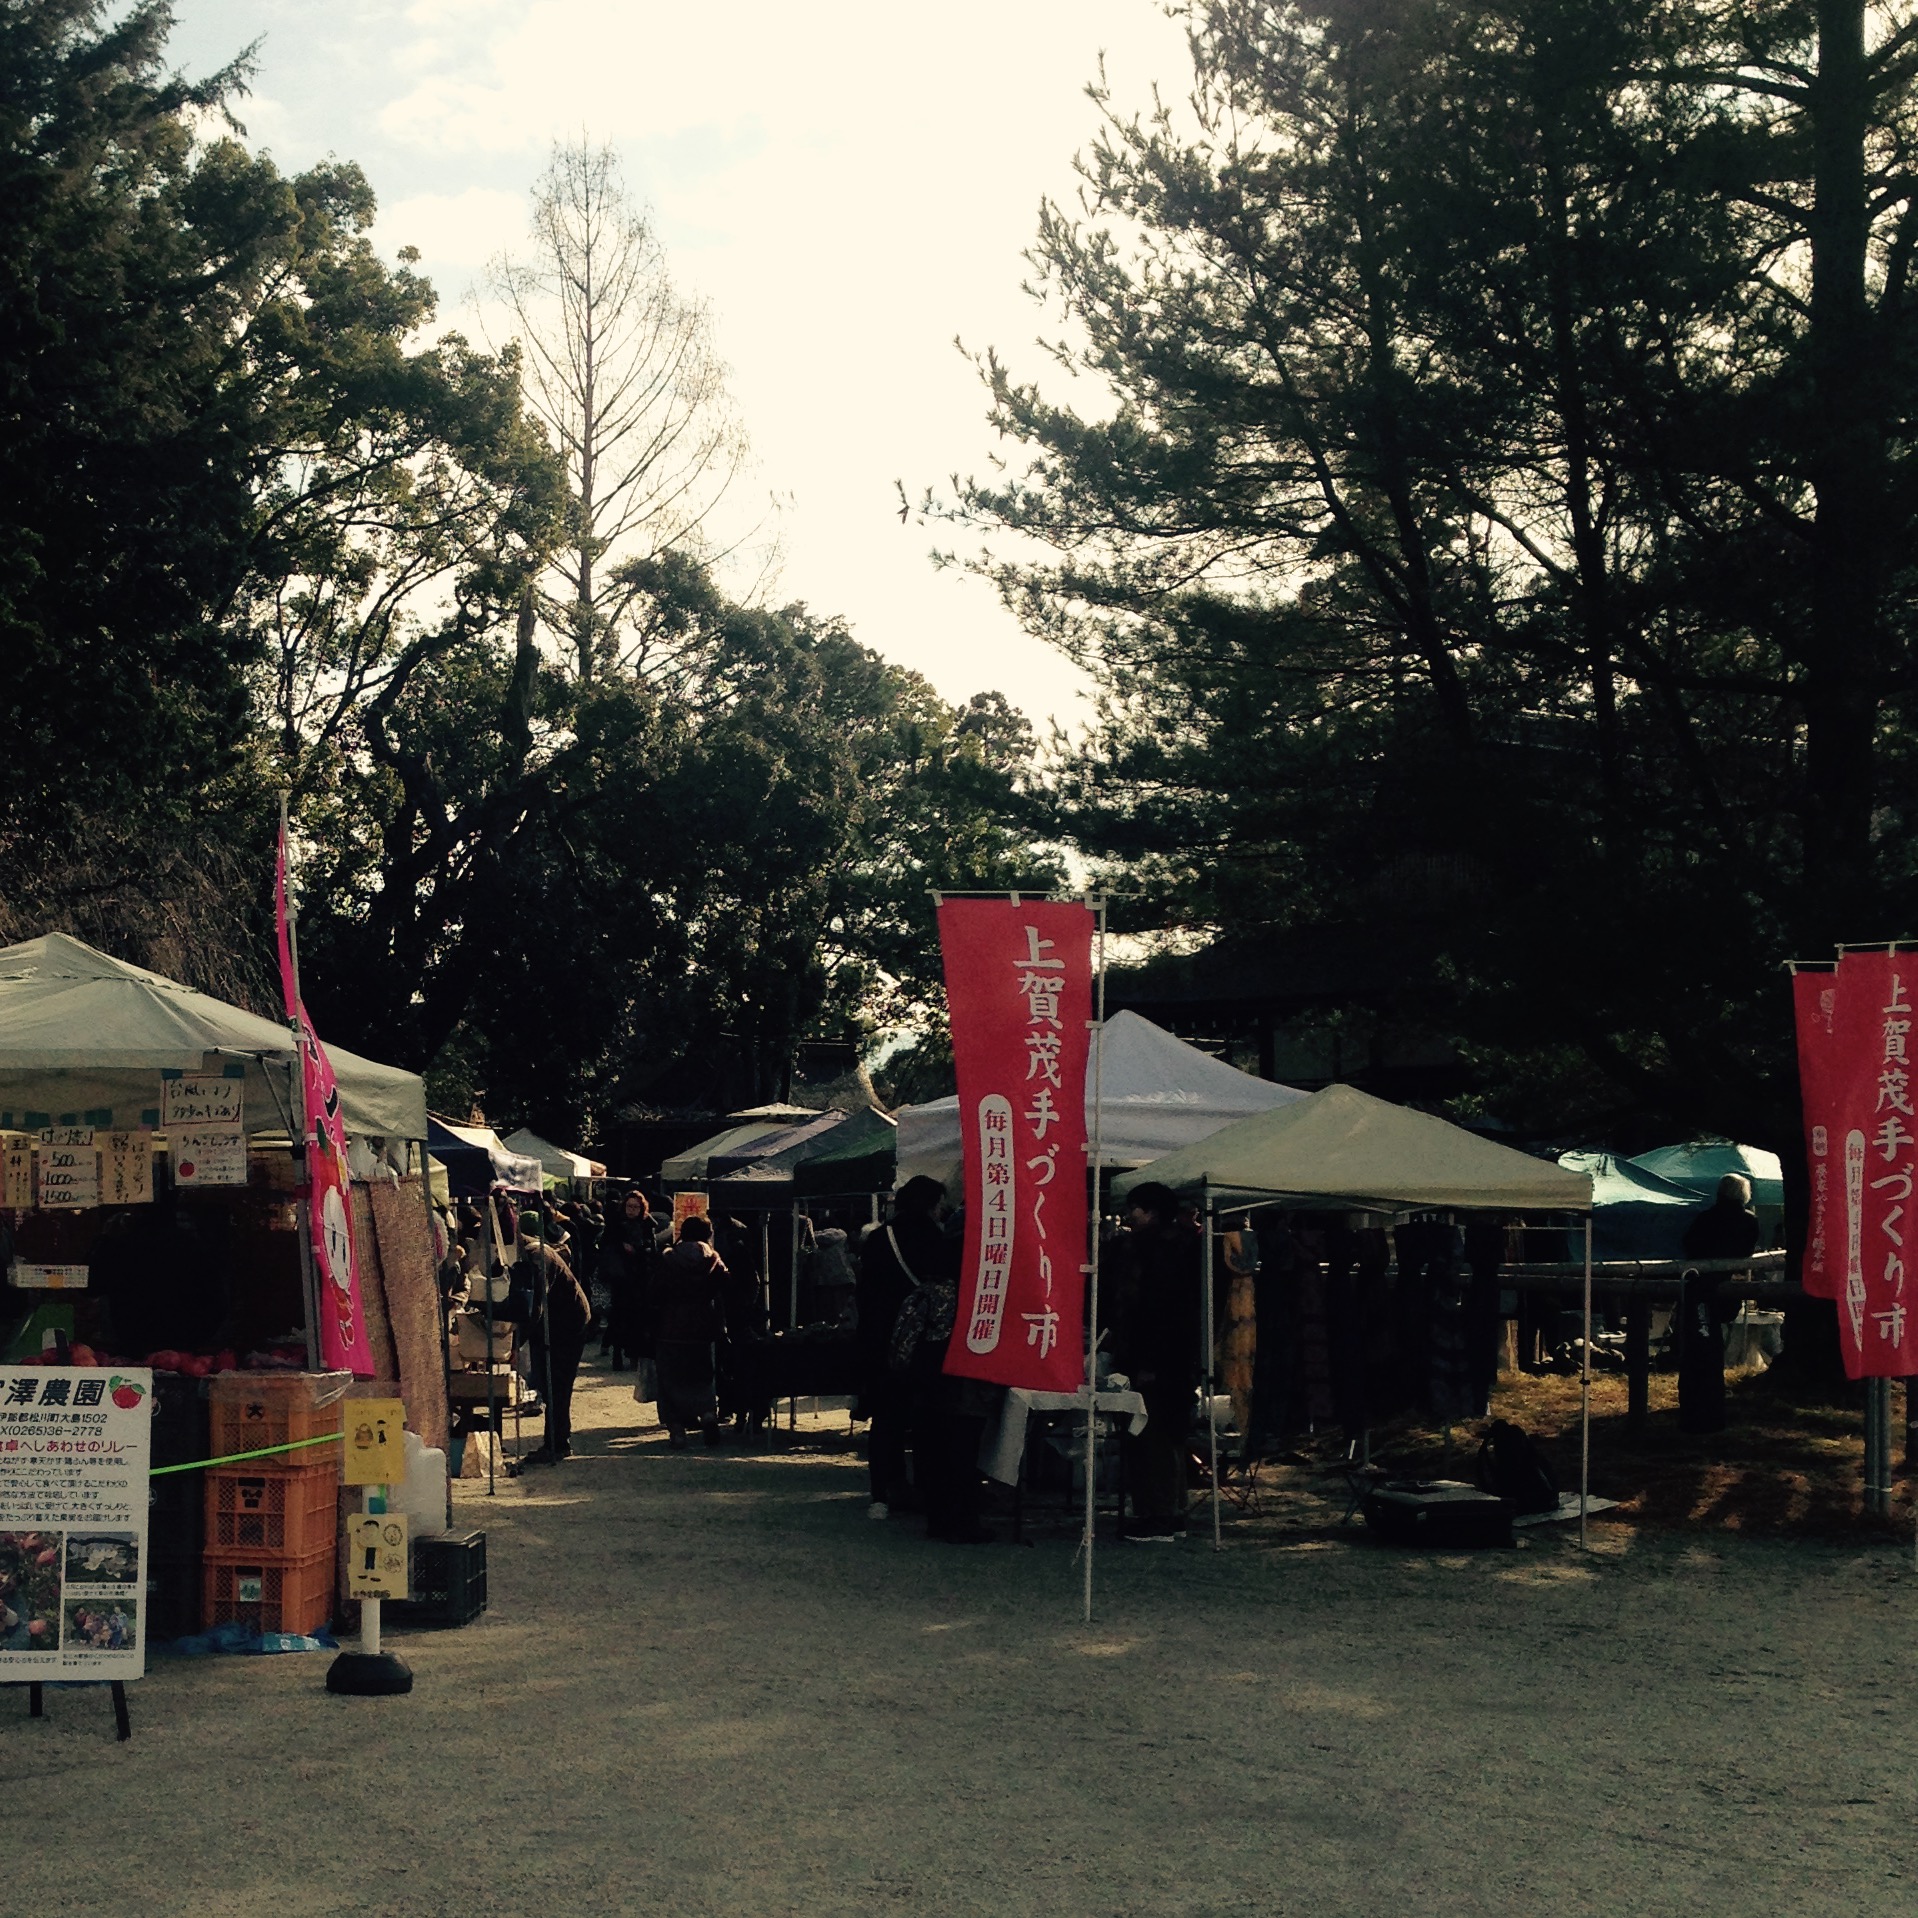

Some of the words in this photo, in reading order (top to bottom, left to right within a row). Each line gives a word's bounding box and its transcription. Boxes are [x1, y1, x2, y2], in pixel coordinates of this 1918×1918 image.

[971, 1108, 1010, 1340] 毎月第4日曜日開催
[1012, 925, 1066, 1360] 上賀茂手づくり市
[1869, 974, 1915, 1350] 上賀茂手づくり市
[0, 1378, 106, 1406] 澤農園
[0, 1439, 138, 1453] 卓へしあわせのリレー
